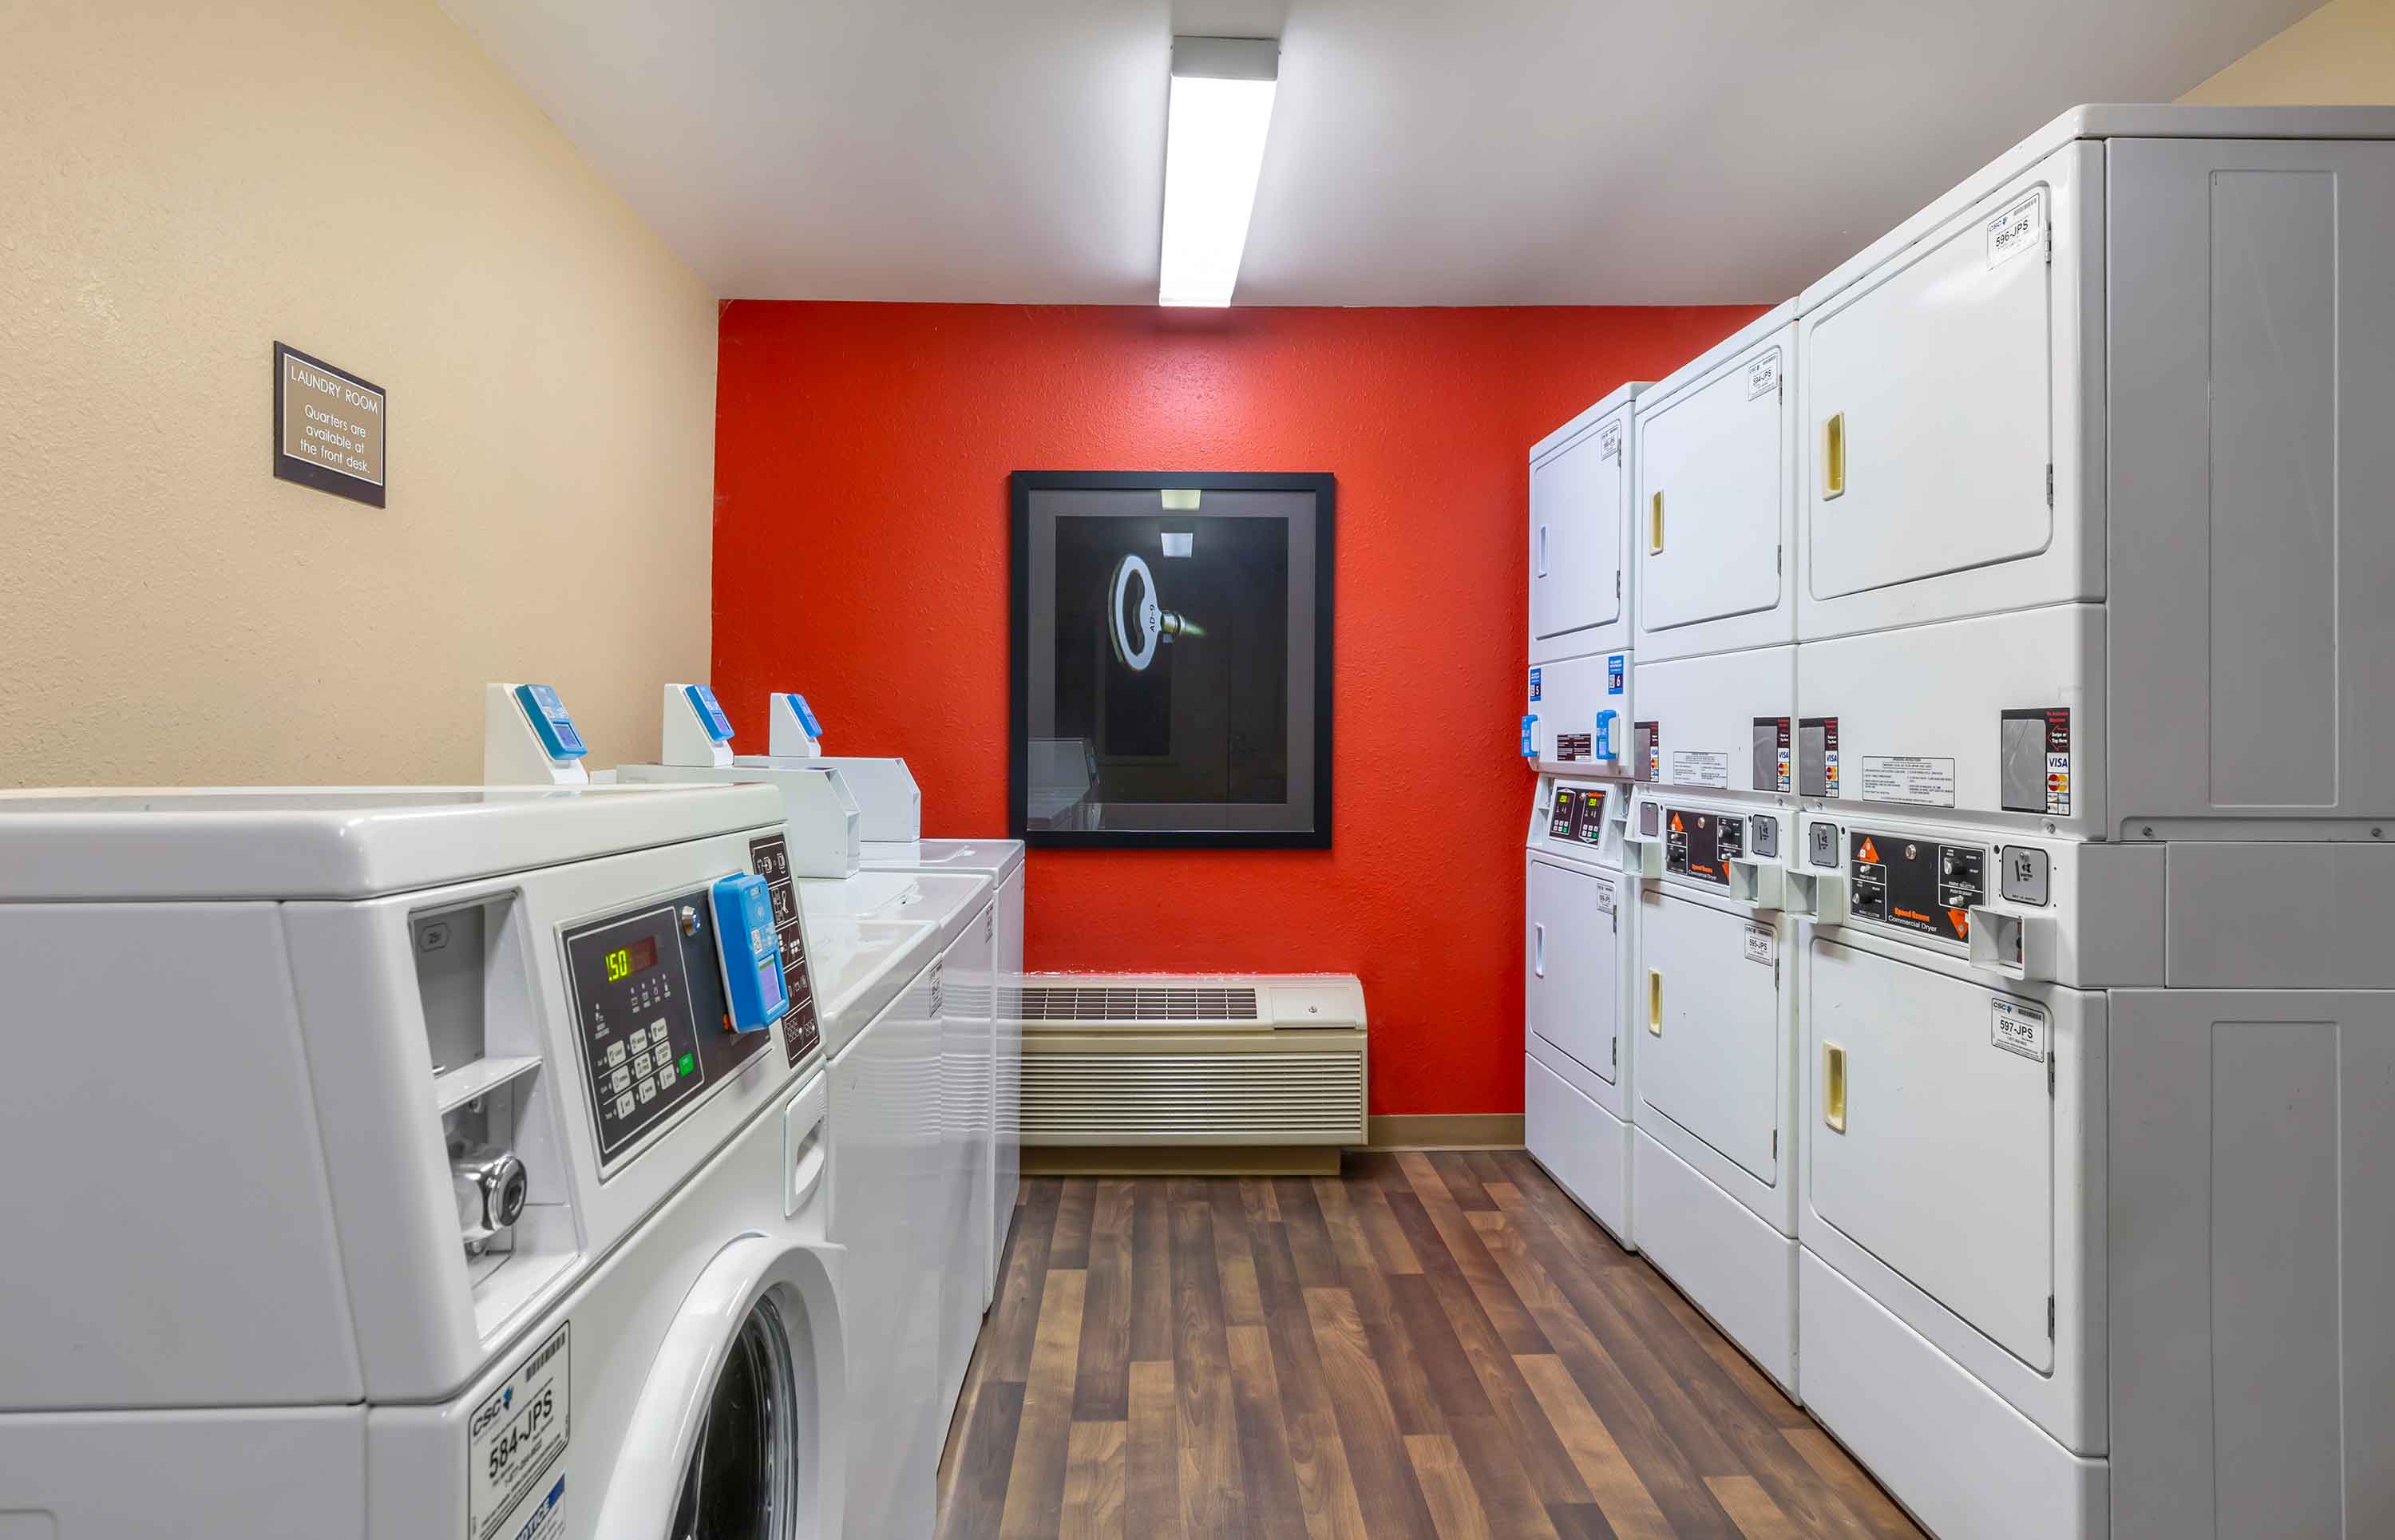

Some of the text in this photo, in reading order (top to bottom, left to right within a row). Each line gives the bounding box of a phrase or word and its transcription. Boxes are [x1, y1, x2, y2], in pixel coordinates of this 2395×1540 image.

[1996, 220, 2028, 247] 596-JPS
[291, 365, 378, 414] LAUNDRY ROOM
[305, 405, 366, 437] Quarters are
[307, 425, 365, 454] available at
[300, 439, 370, 473] the front desk.
[1535, 686, 1539, 695] 5
[1616, 675, 1621, 687] 6
[2049, 758, 2068, 767] VISA
[1888, 915, 1937, 932] Commercial Dryer
[1993, 1002, 2006, 1011] CSC
[2000, 1019, 2033, 1039] 597-JPS
[473, 1399, 501, 1437] CSC
[489, 1389, 552, 1479] 584-JPS
